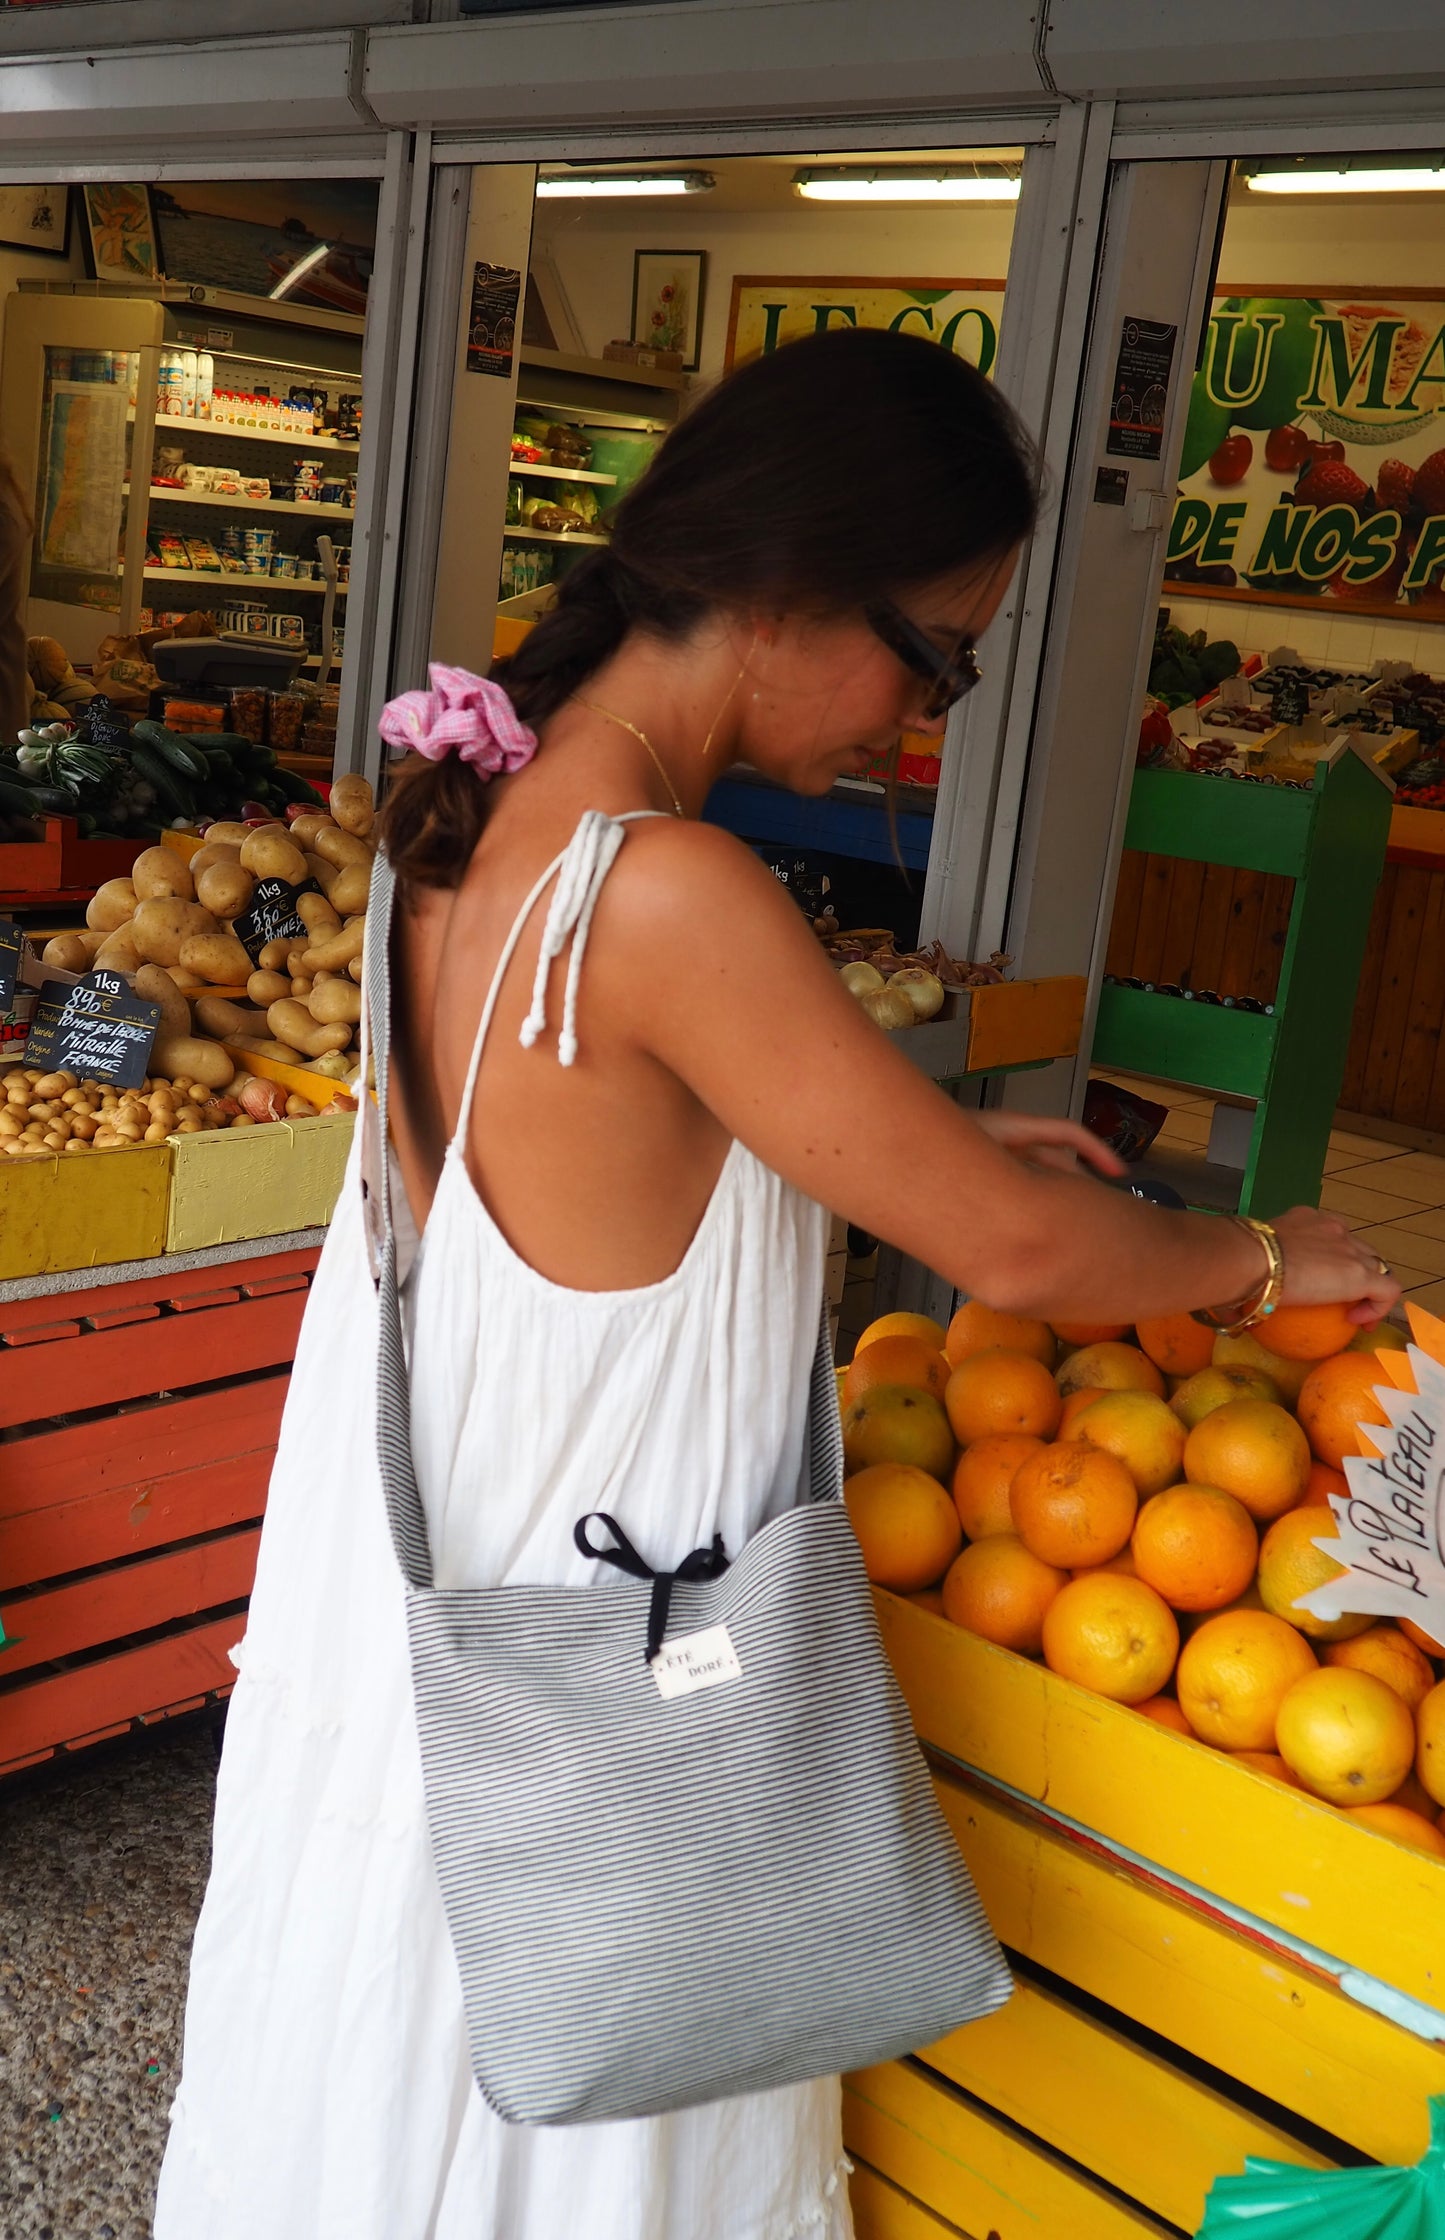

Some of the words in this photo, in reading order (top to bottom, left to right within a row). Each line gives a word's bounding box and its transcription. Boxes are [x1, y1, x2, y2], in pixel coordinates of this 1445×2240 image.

[1166, 498, 1248, 566] DE
[1249, 503, 1402, 584] NOS
[258, 883, 281, 900] 1kg
[94, 972, 121, 995] 1kg
[60, 1051, 123, 1073] FRANCE
[1351, 1547, 1428, 1598] LE
